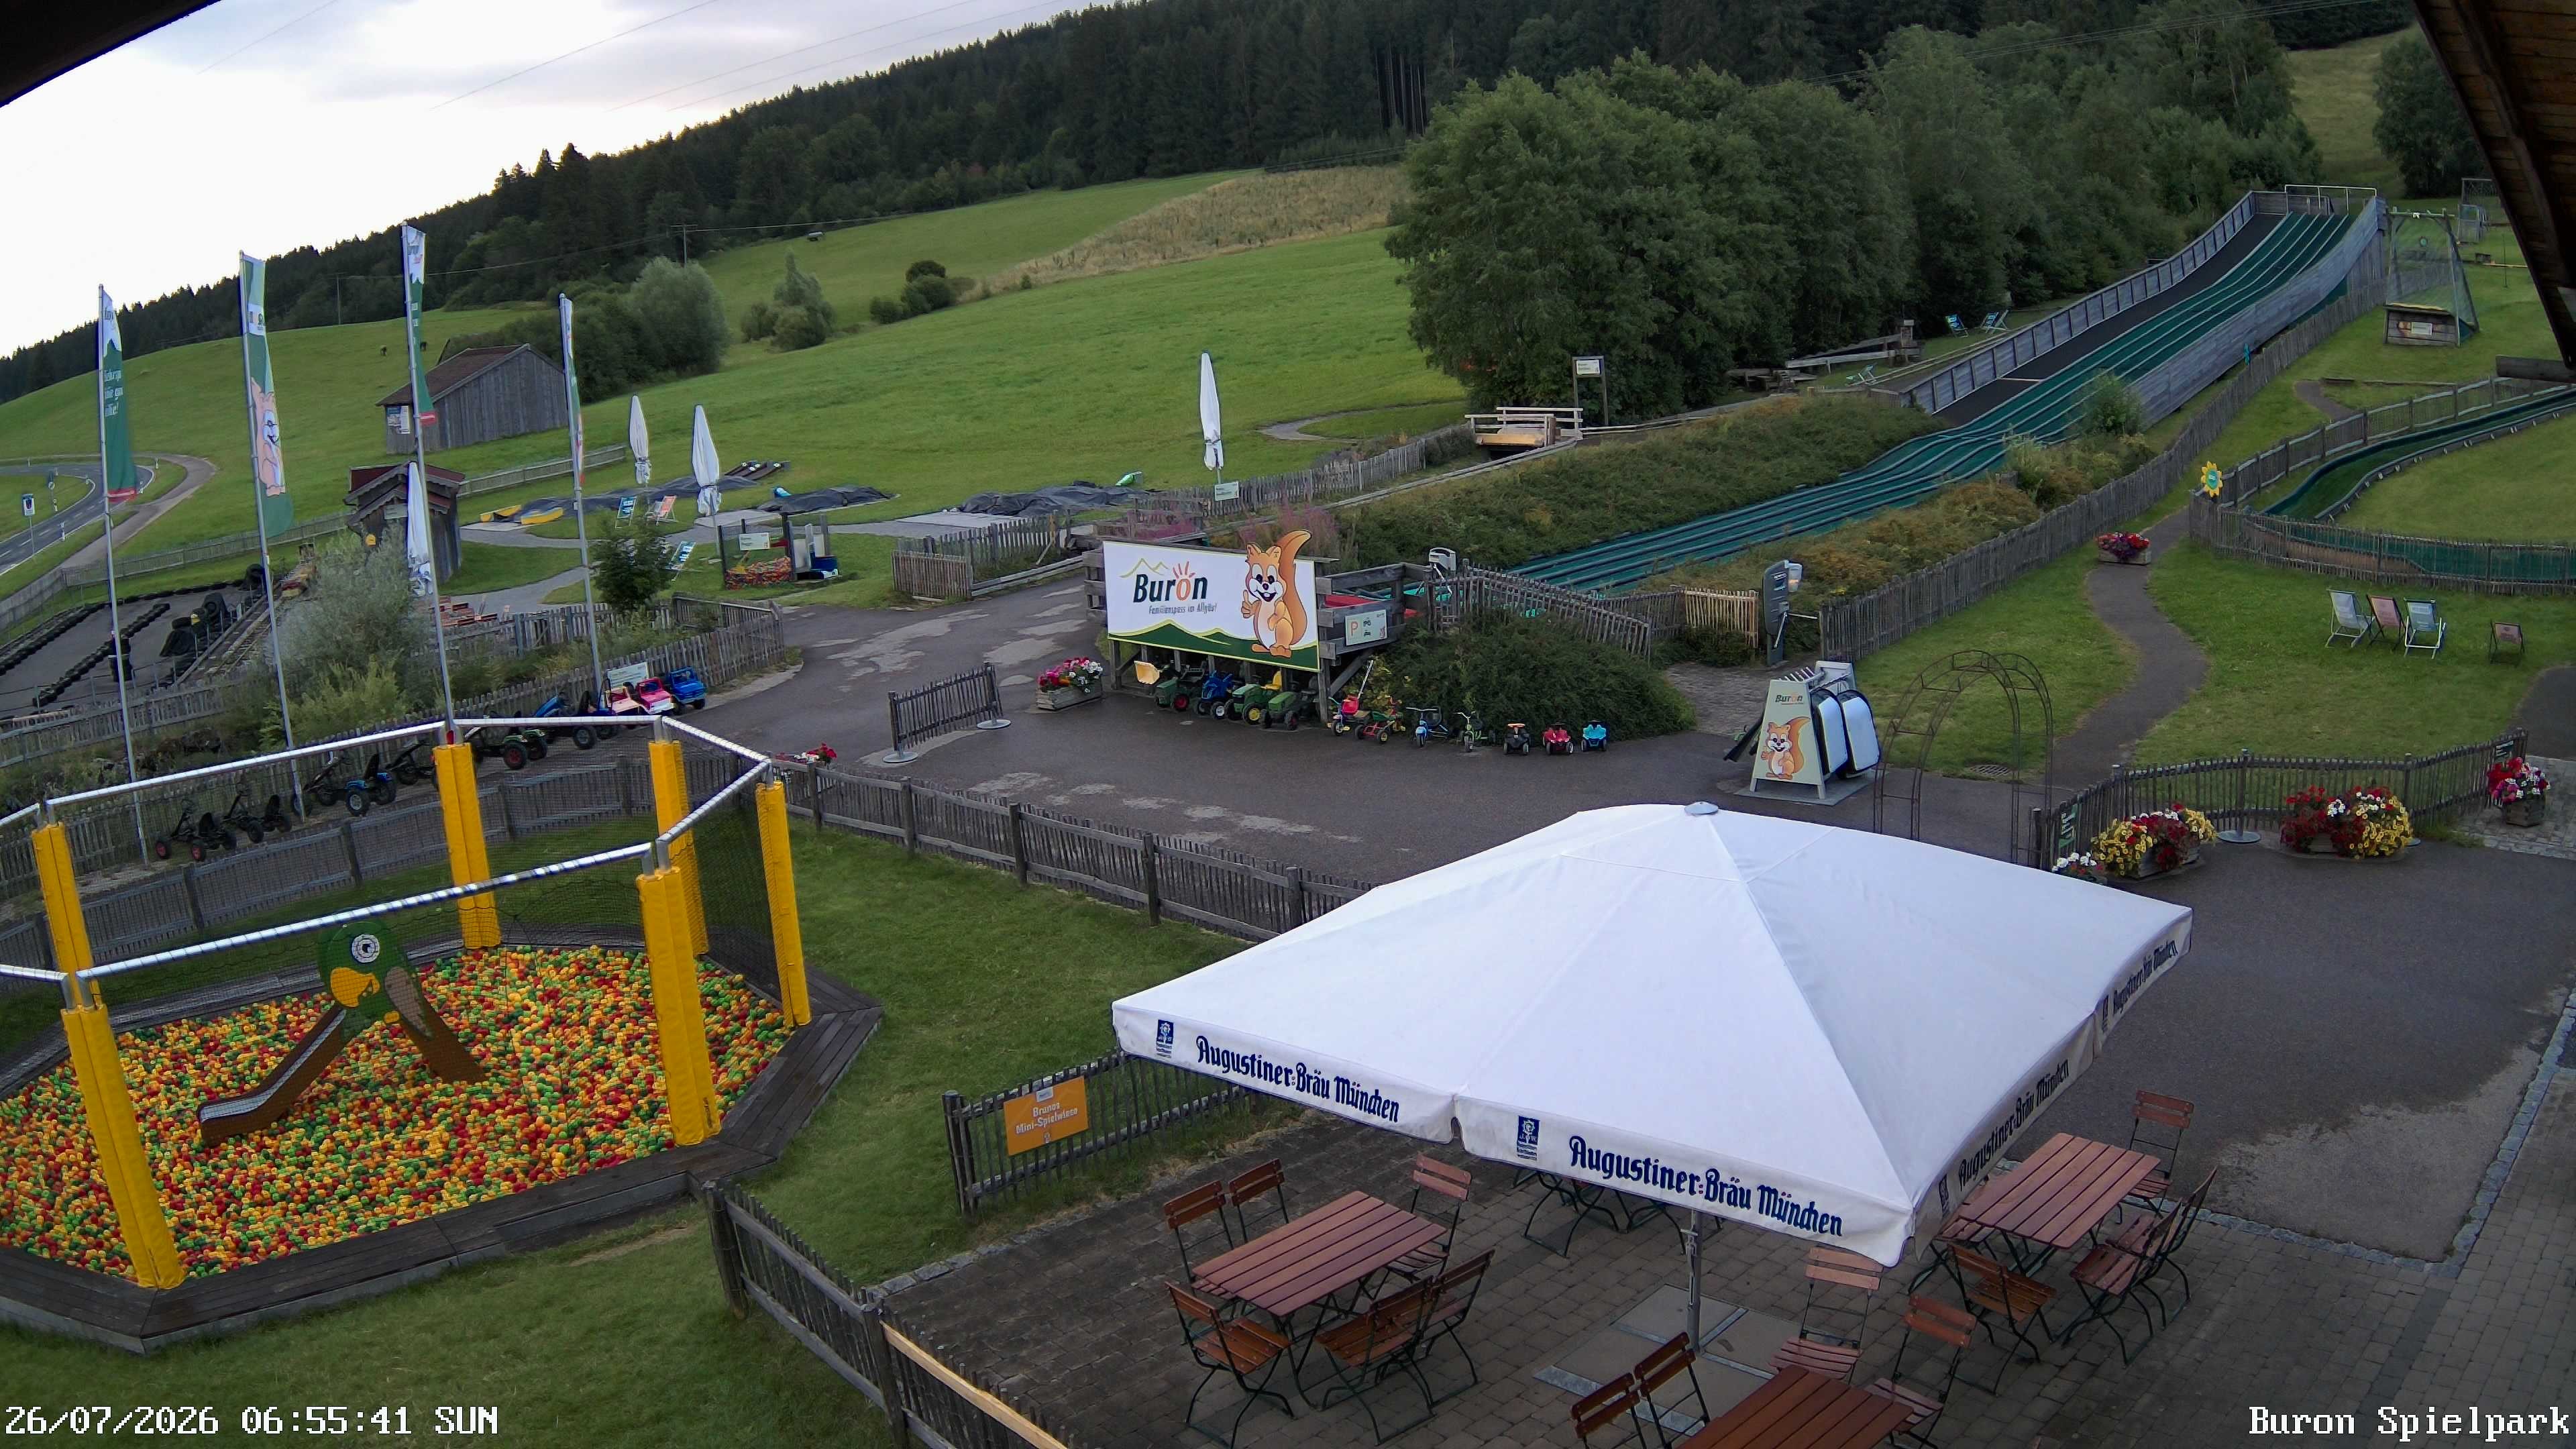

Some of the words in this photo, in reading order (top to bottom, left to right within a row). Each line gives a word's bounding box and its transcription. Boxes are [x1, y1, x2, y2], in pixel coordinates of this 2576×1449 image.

[1132, 574, 1208, 603] Buron
[1334, 1075, 1399, 1123] München
[1757, 1183, 1843, 1237] München
